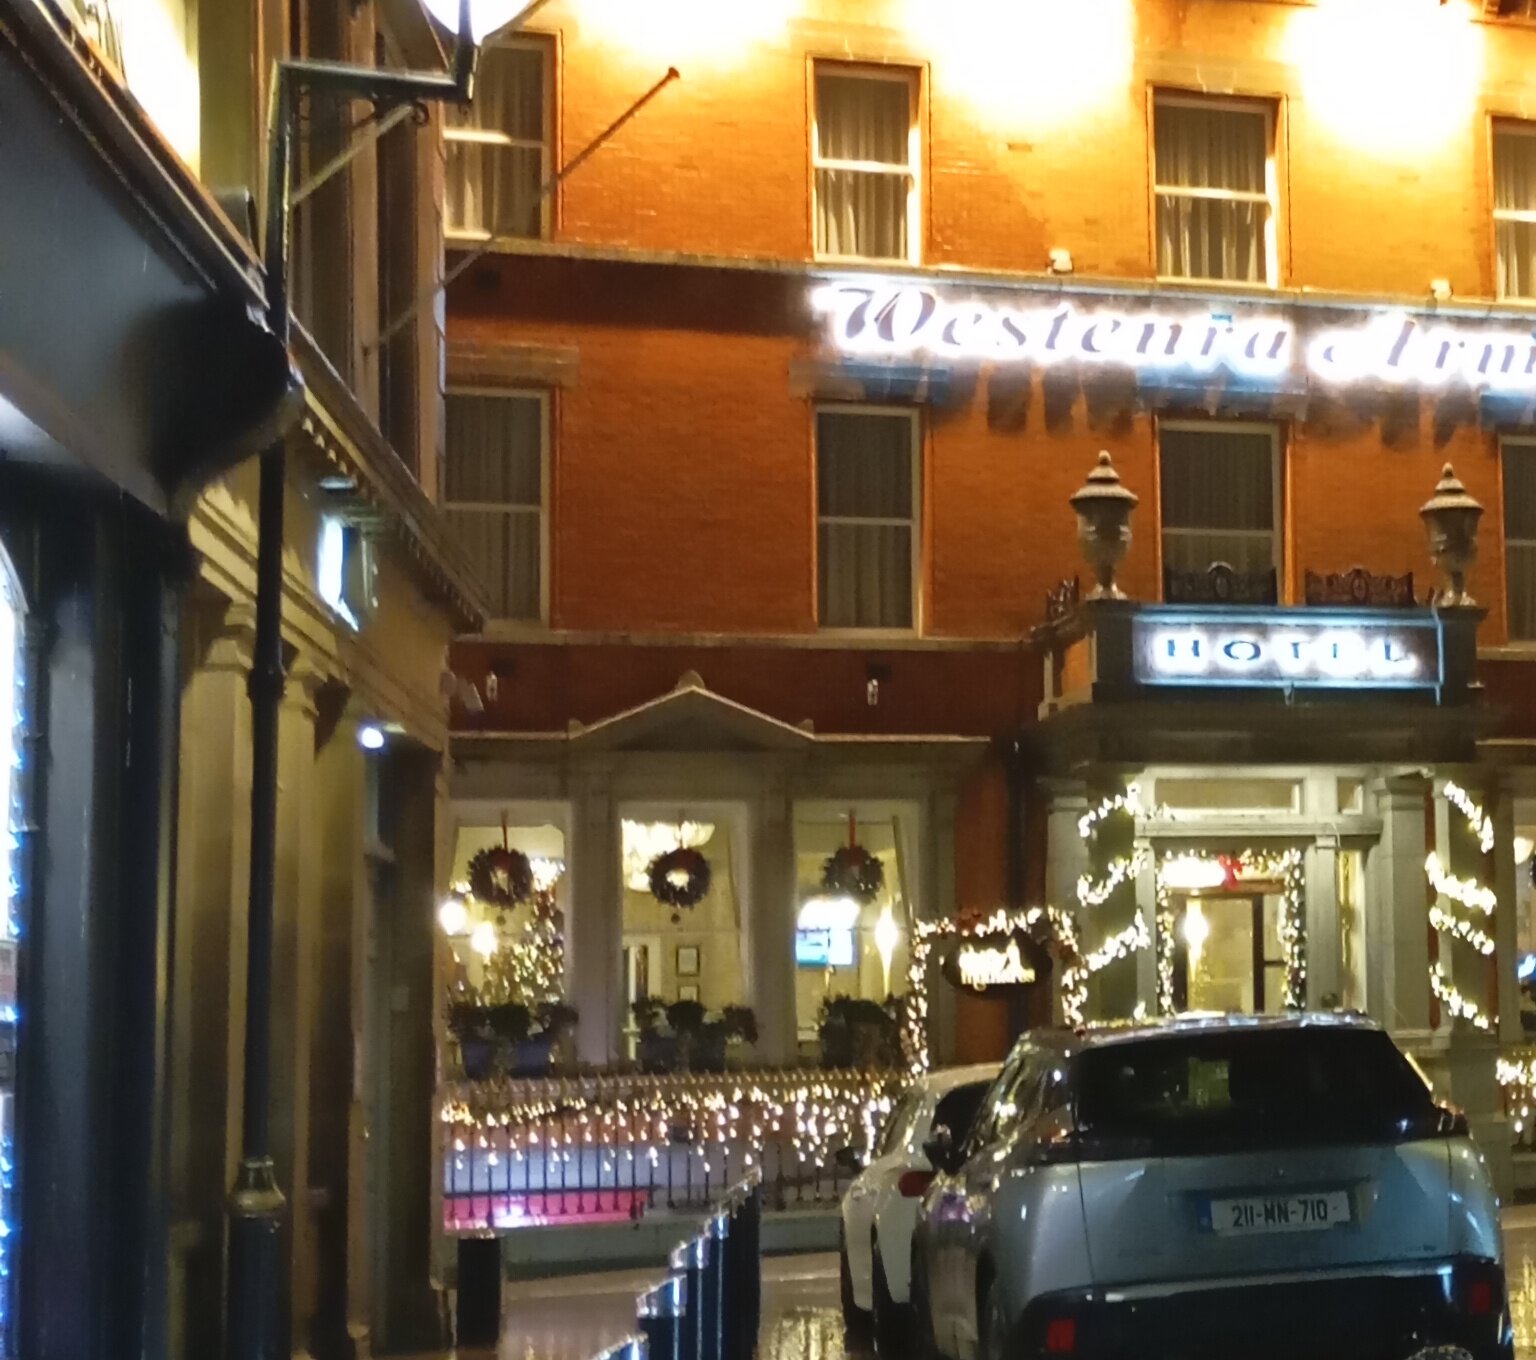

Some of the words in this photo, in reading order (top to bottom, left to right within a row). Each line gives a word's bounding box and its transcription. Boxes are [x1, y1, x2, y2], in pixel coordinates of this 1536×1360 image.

[824, 281, 1291, 364] Westenra
[1156, 632, 1417, 672] HOTEL
[1231, 1198, 1329, 1228] 211-MN-710
